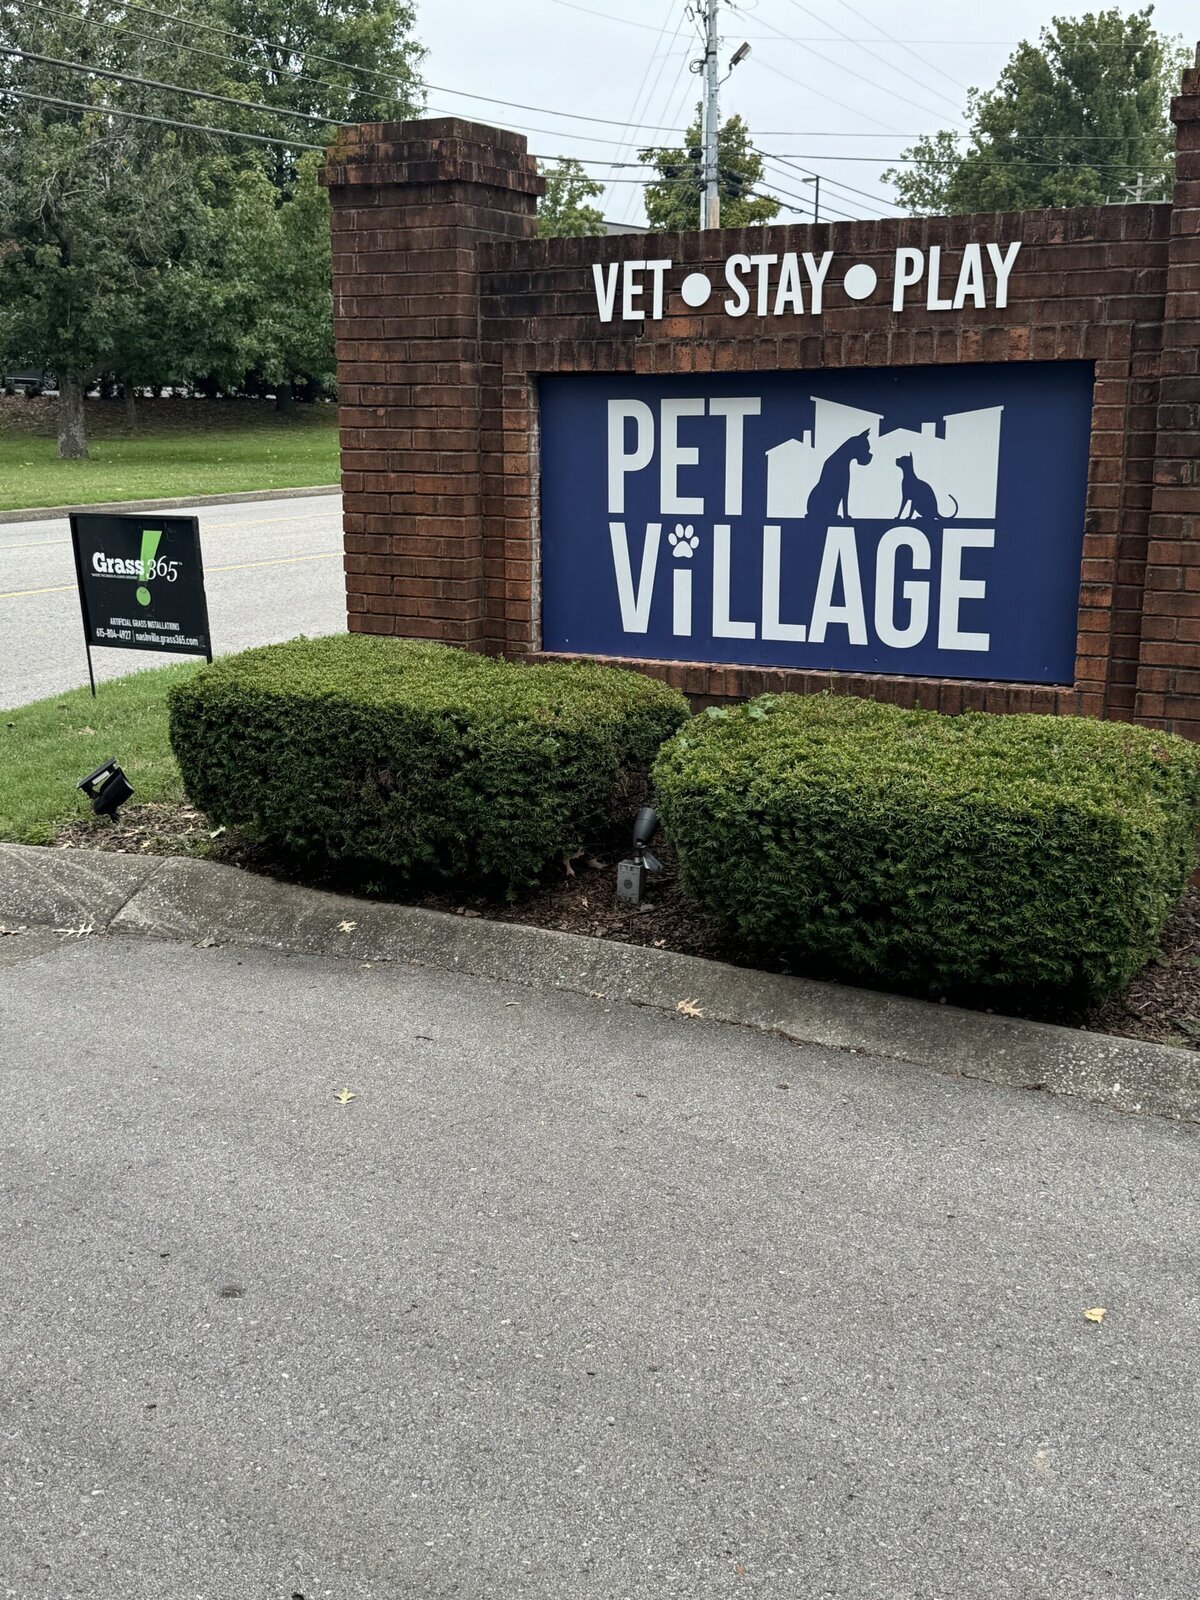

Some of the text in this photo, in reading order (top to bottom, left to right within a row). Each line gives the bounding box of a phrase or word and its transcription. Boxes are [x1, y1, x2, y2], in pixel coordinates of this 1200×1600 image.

[592, 241, 1022, 323] VET STAY PLAY
[607, 396, 762, 516] PET
[110, 617, 180, 631] ARTIFICIAL GRASS INSTALLATIONS
